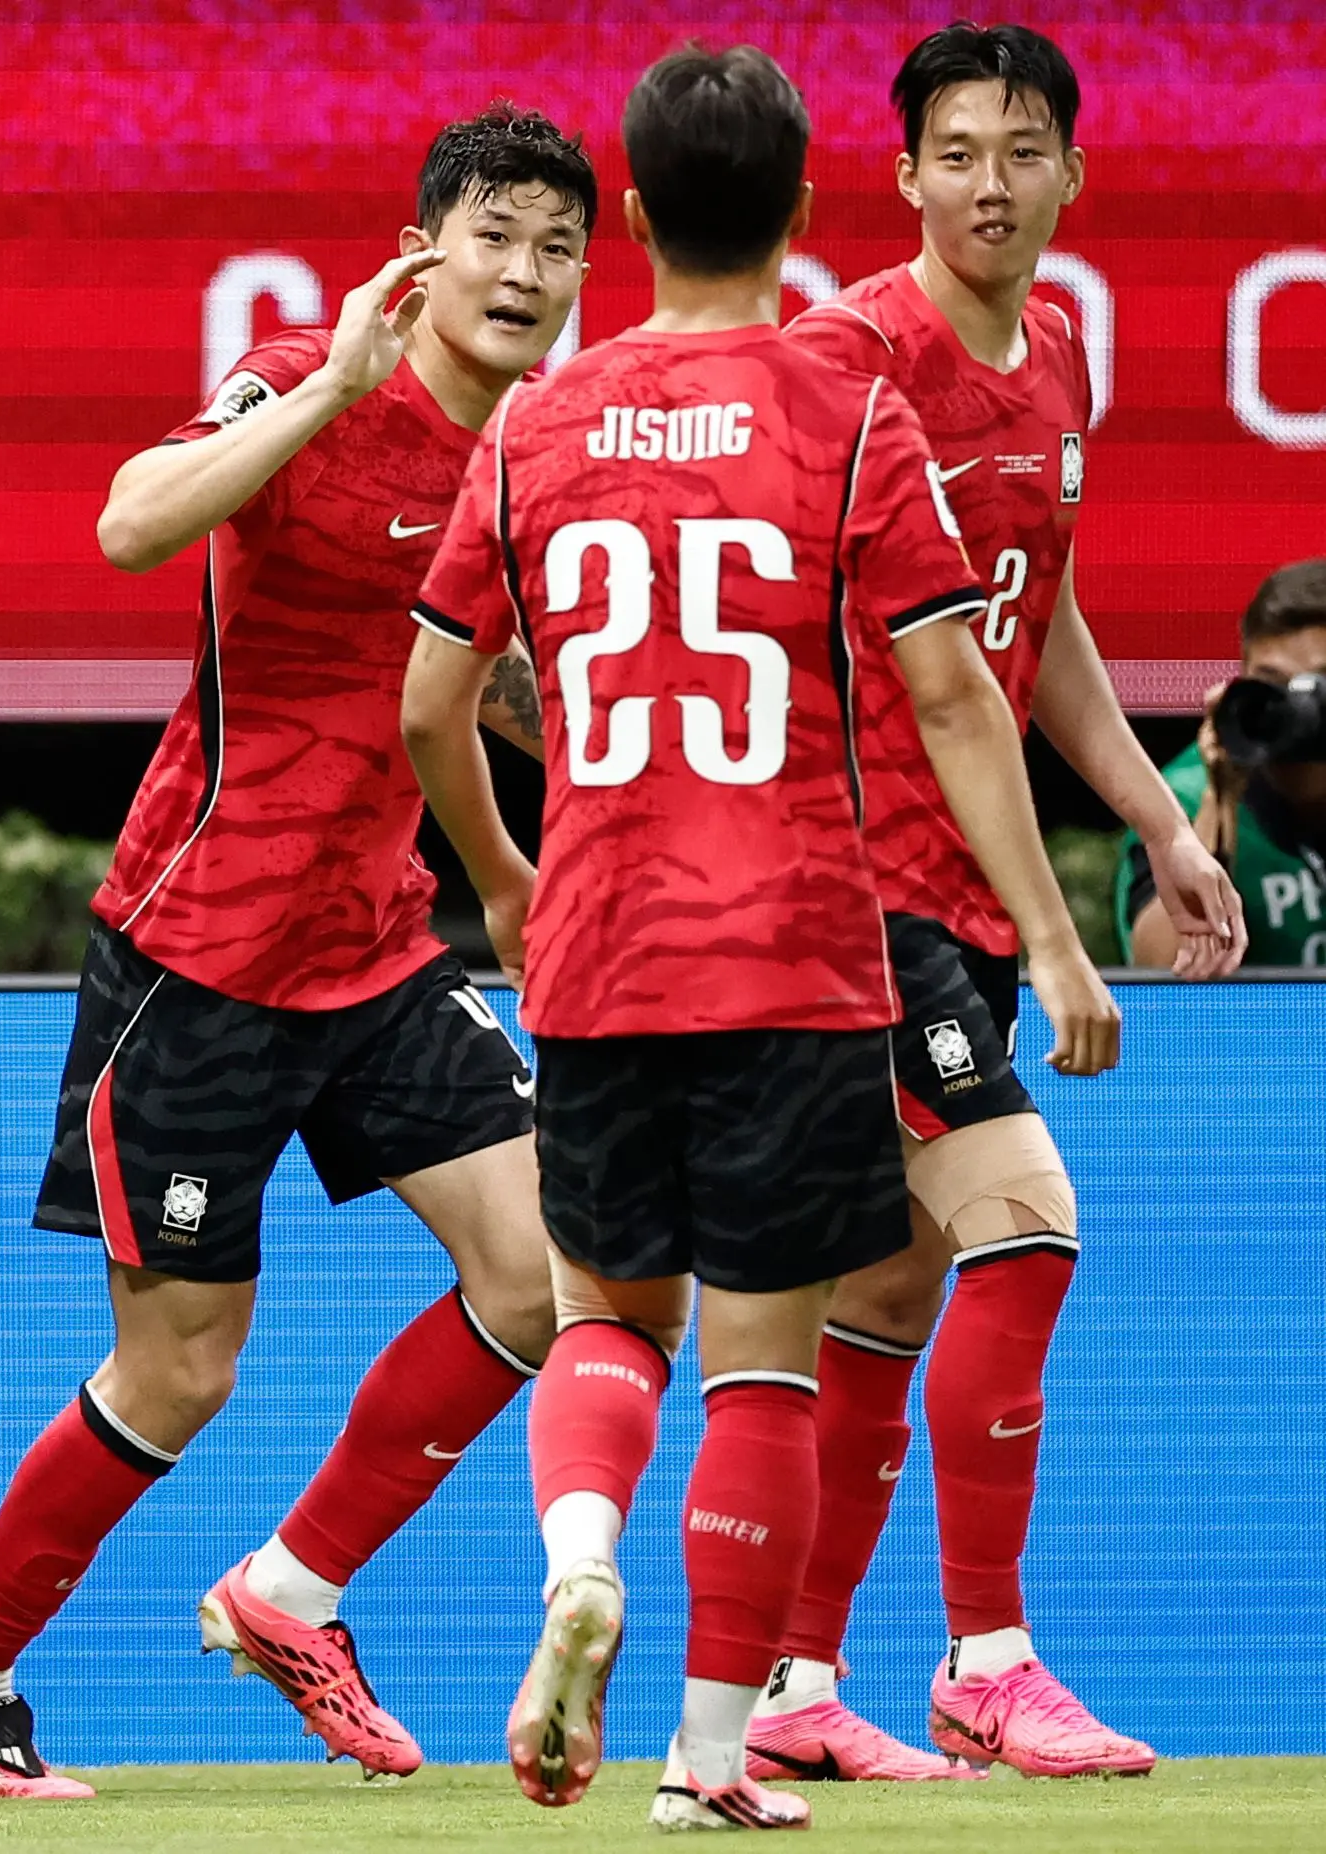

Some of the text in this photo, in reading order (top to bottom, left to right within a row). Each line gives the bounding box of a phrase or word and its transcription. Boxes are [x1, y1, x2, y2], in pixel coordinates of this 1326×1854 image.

[586, 402, 754, 463] JISUNG
[983, 548, 1028, 651] 2
[544, 518, 799, 787] 25
[943, 1075, 982, 1095] KOREA
[158, 1229, 197, 1246] KOREA
